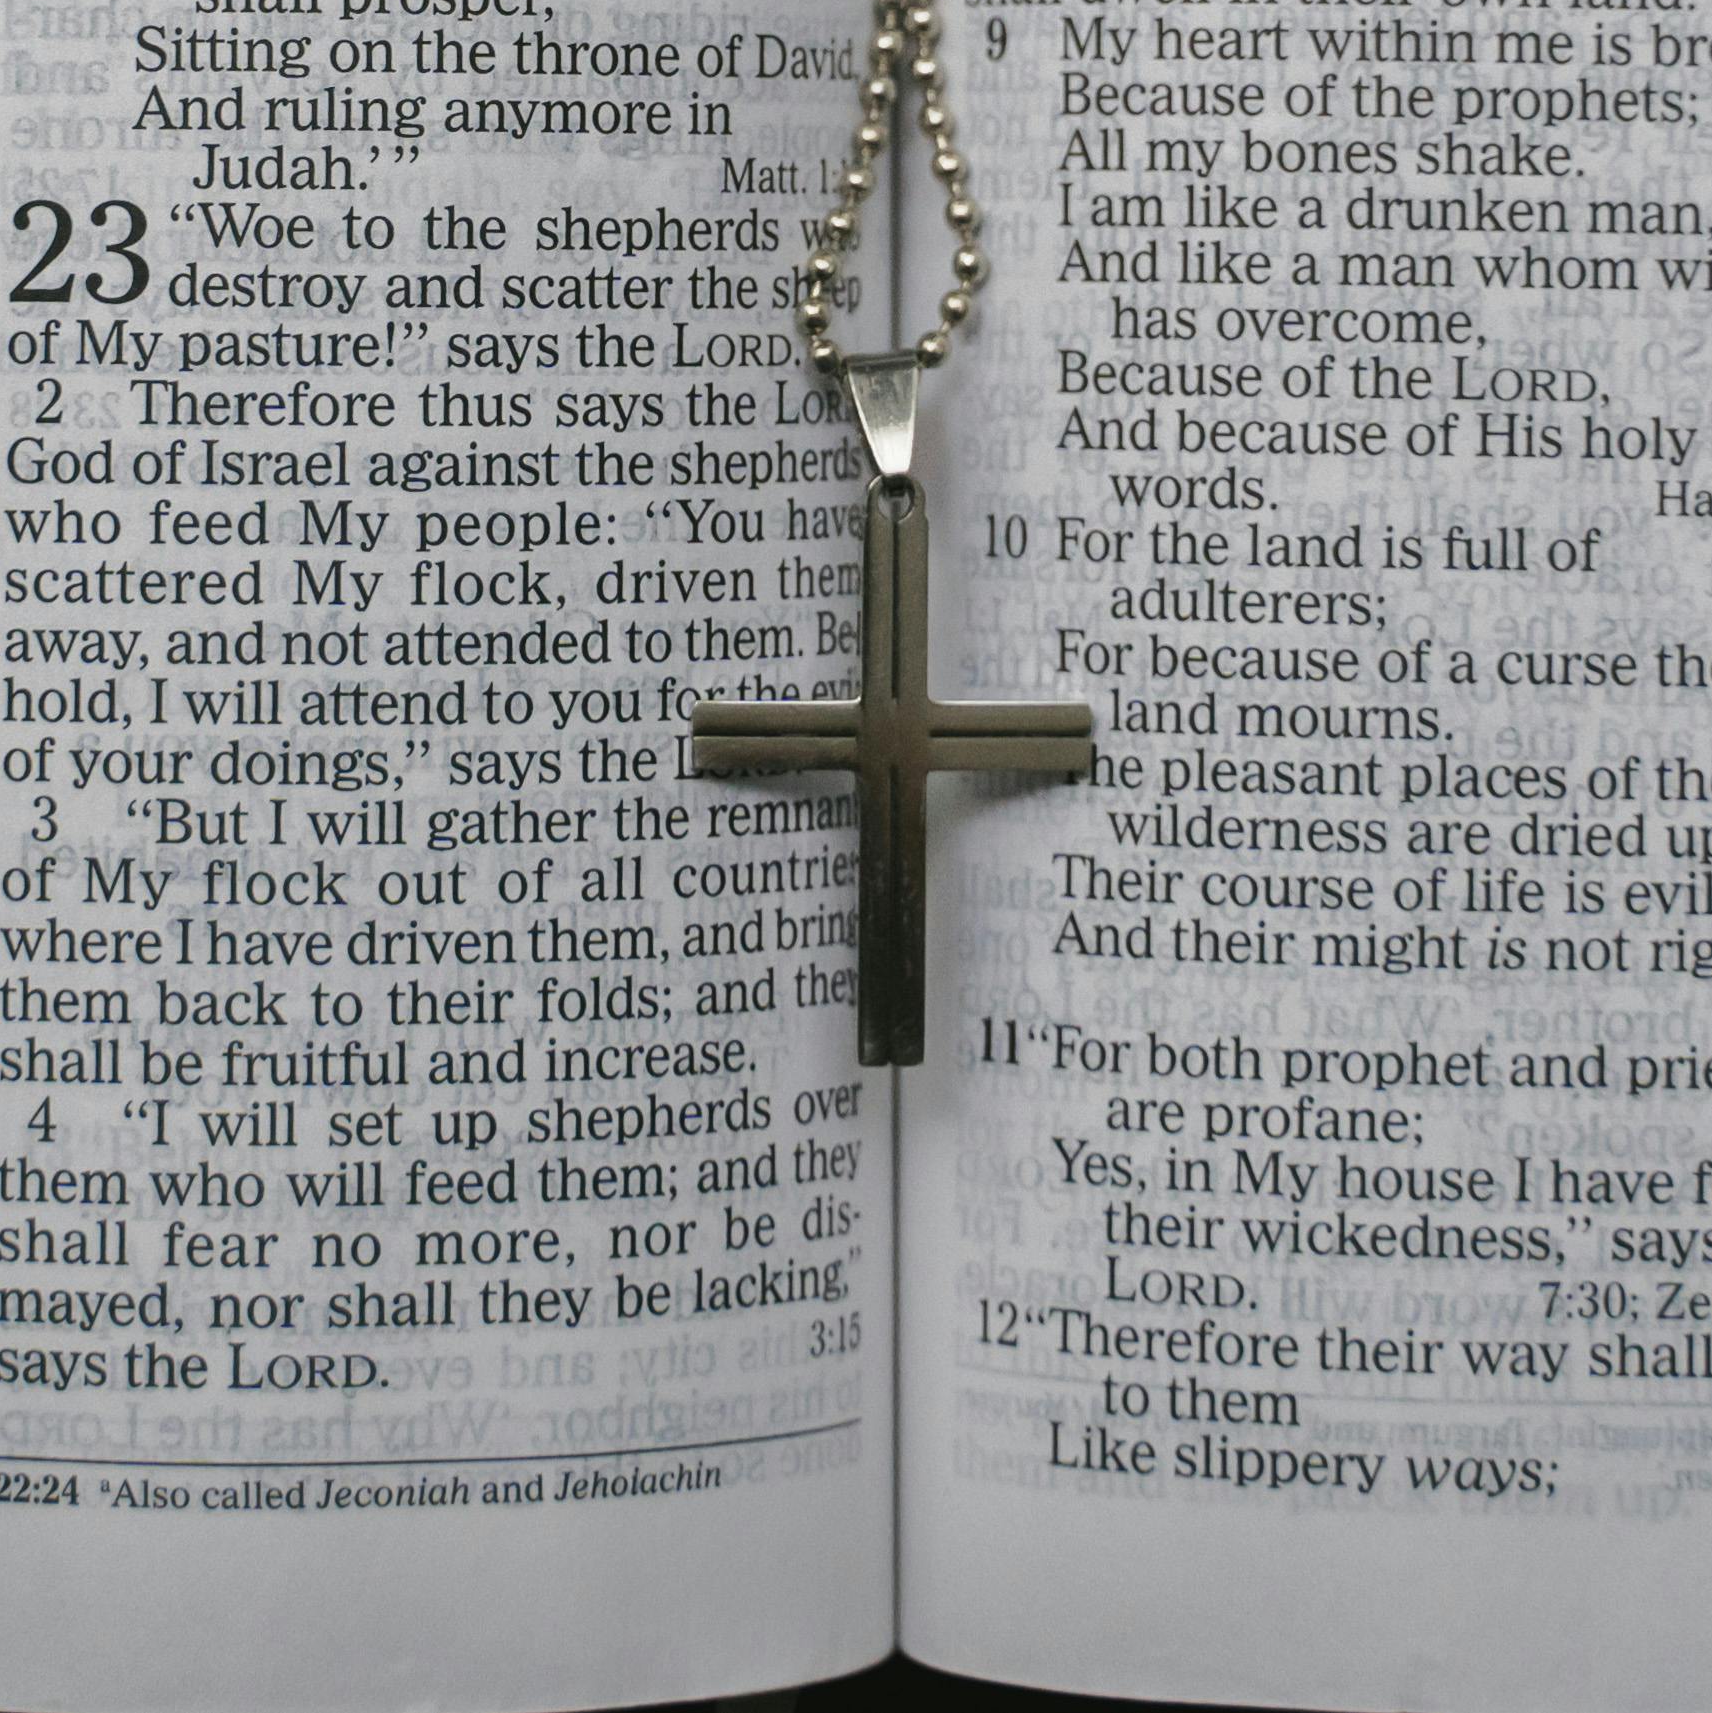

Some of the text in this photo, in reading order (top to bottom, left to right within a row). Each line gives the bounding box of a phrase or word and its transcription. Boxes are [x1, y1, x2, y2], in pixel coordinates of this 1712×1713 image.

[984, 18, 1009, 61] 9
[1061, 15, 1137, 67] My
[1154, 17, 1290, 62] heart
[1306, 18, 1478, 64] within
[1495, 31, 1576, 67] me
[1592, 22, 1633, 67] is
[8, 198, 150, 306] 23
[7, 318, 62, 366] of
[74, 319, 165, 372] My
[446, 332, 561, 376] says
[574, 322, 656, 370] the
[671, 322, 803, 369] LORD.
[1109, 472, 1280, 512] words.
[1051, 852, 1180, 905] Their
[1200, 872, 1375, 912] course
[1392, 866, 1449, 913] of
[1462, 866, 1545, 915] life
[1565, 868, 1606, 915] is
[0, 1036, 758, 1088] shall be fruitful and increase.
[1051, 1136, 1148, 1192] Yes,
[1166, 1154, 1215, 1200] in
[1233, 1149, 1319, 1206] My
[1338, 1154, 1495, 1204] house
[1513, 1156, 1533, 1204] I
[1550, 1158, 1675, 1206] have
[1105, 1253, 1259, 1310] LORD.
[1537, 1280, 1640, 1324] 7:30;
[808, 1317, 862, 1360] 3:15
[123, 1341, 209, 1390] the
[227, 1341, 391, 1391] LORD.
[201, 1478, 307, 1511] called
[315, 1474, 470, 1510] Jeconiah
[481, 1473, 545, 1506] and
[553, 1461, 723, 1502] Jehoiachin
